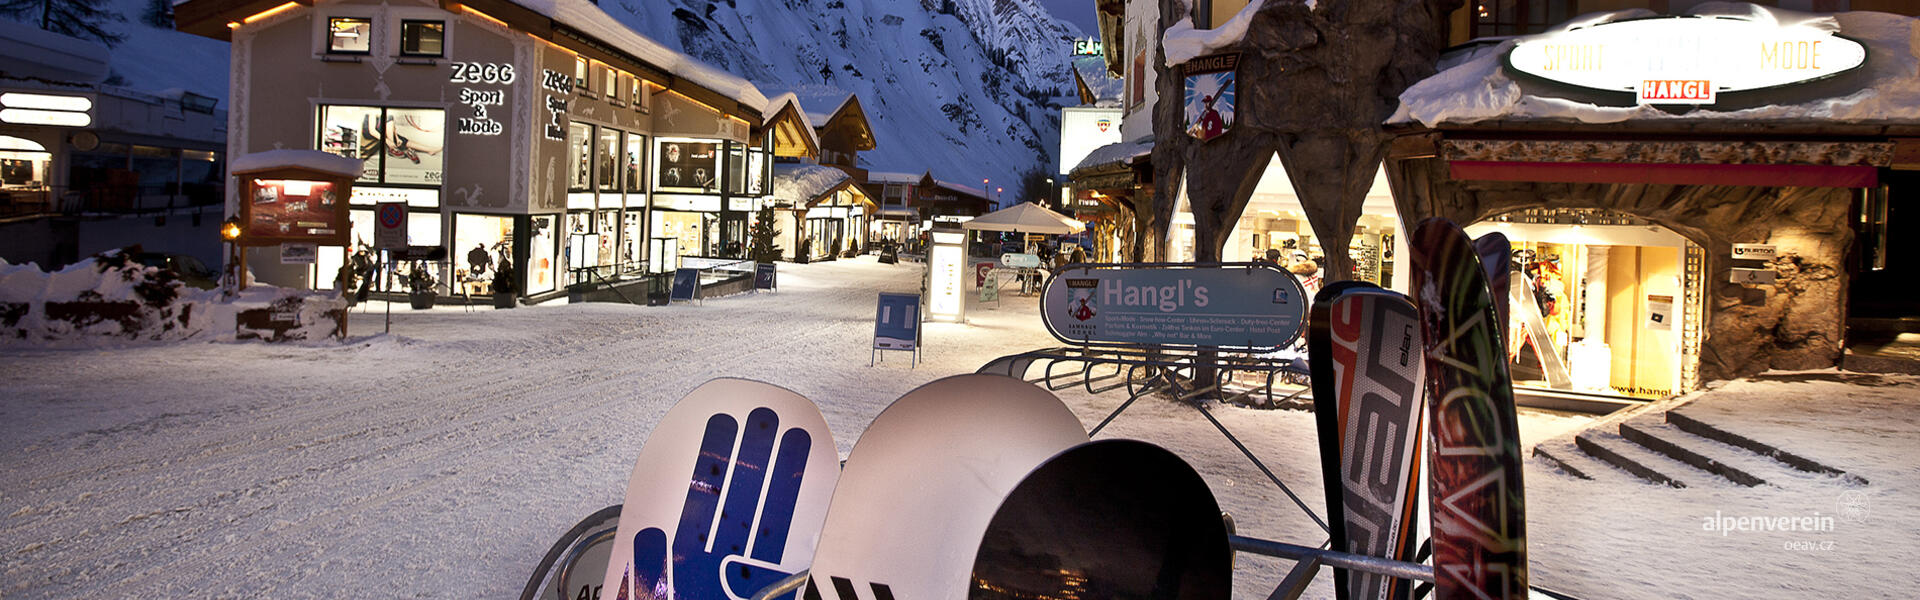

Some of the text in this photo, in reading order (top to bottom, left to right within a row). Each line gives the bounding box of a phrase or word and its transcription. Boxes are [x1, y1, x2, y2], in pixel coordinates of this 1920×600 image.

[1191, 56, 1225, 73] HANGL
[1543, 44, 1608, 71] SPORT
[1760, 41, 1822, 70] MODE
[459, 88, 504, 107] Sport
[1643, 81, 1709, 99] HANGL
[473, 104, 487, 120] &
[458, 119, 502, 135] Mode
[1104, 279, 1209, 311] Hangl's
[1399, 324, 1413, 367] elan
